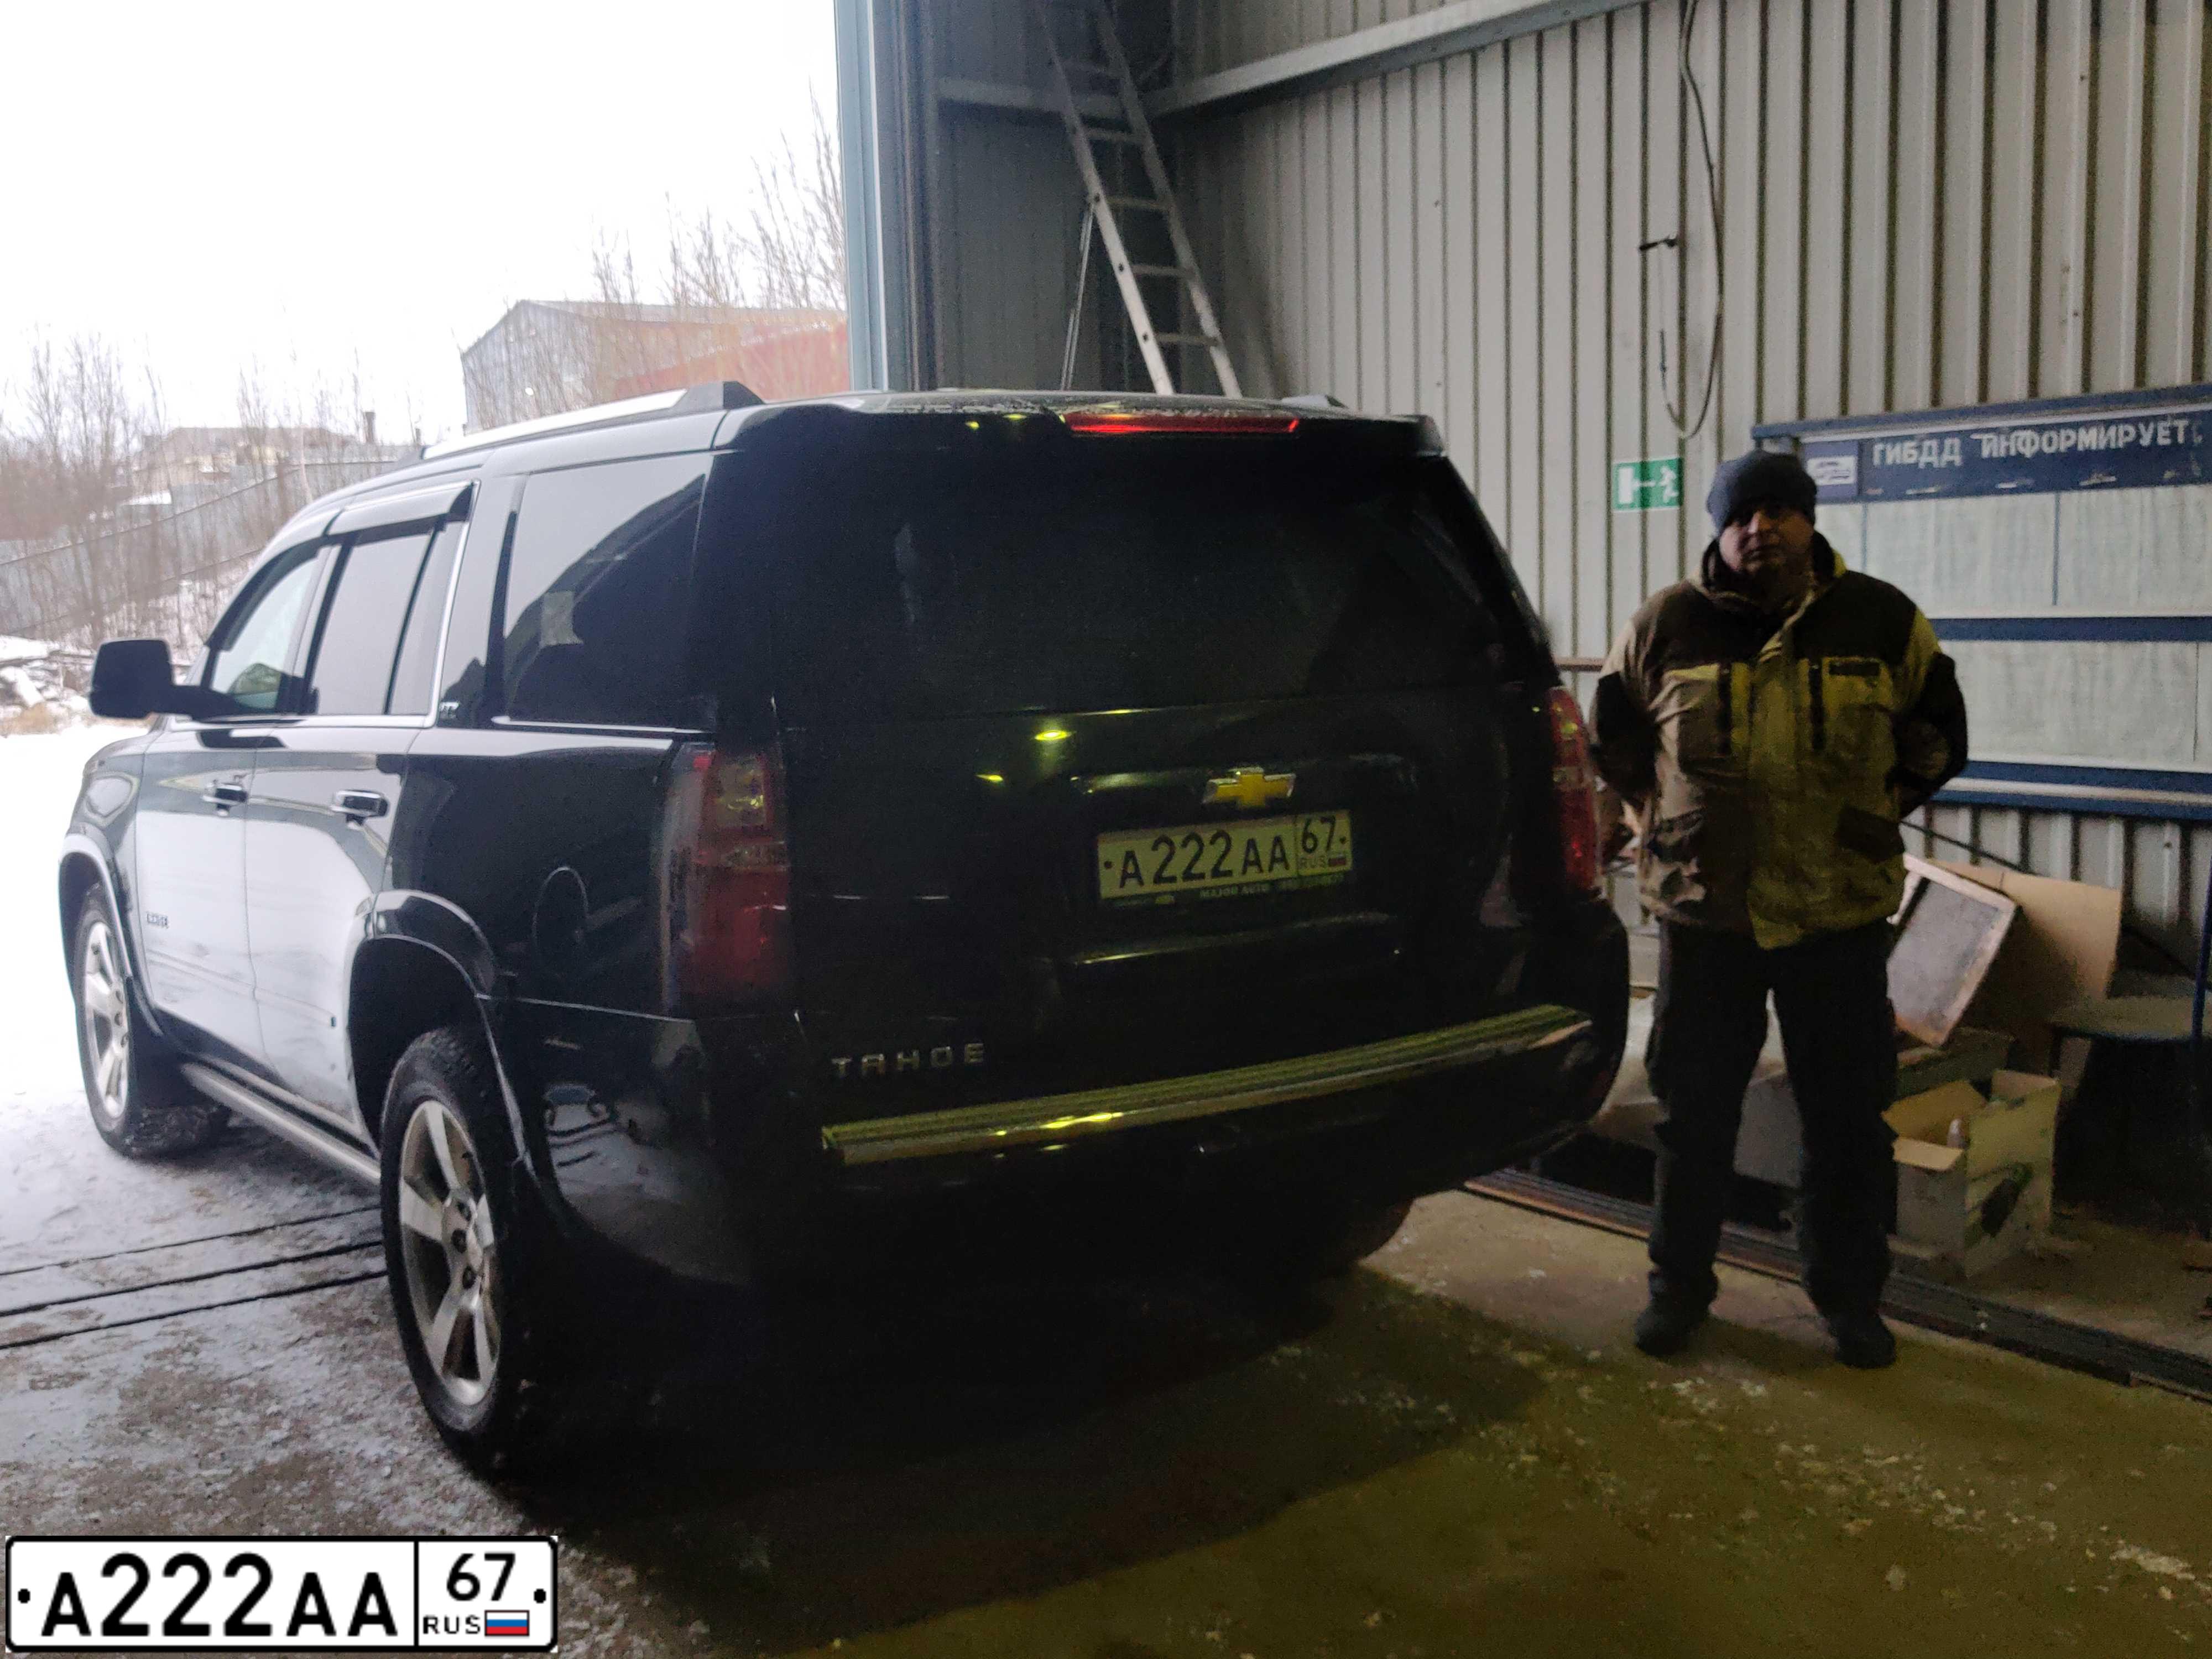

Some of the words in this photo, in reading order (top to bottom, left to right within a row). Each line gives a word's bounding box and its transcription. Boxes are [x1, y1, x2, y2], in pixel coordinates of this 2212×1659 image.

[1872, 436, 1962, 469] ГИБДД
[1980, 419, 2189, 458] ИНФОРМИРУЕТ
[1120, 830, 1290, 888] А222АА
[1302, 816, 1336, 853] 67
[1300, 855, 1326, 869] RUS
[832, 1043, 984, 1078] TAHOE
